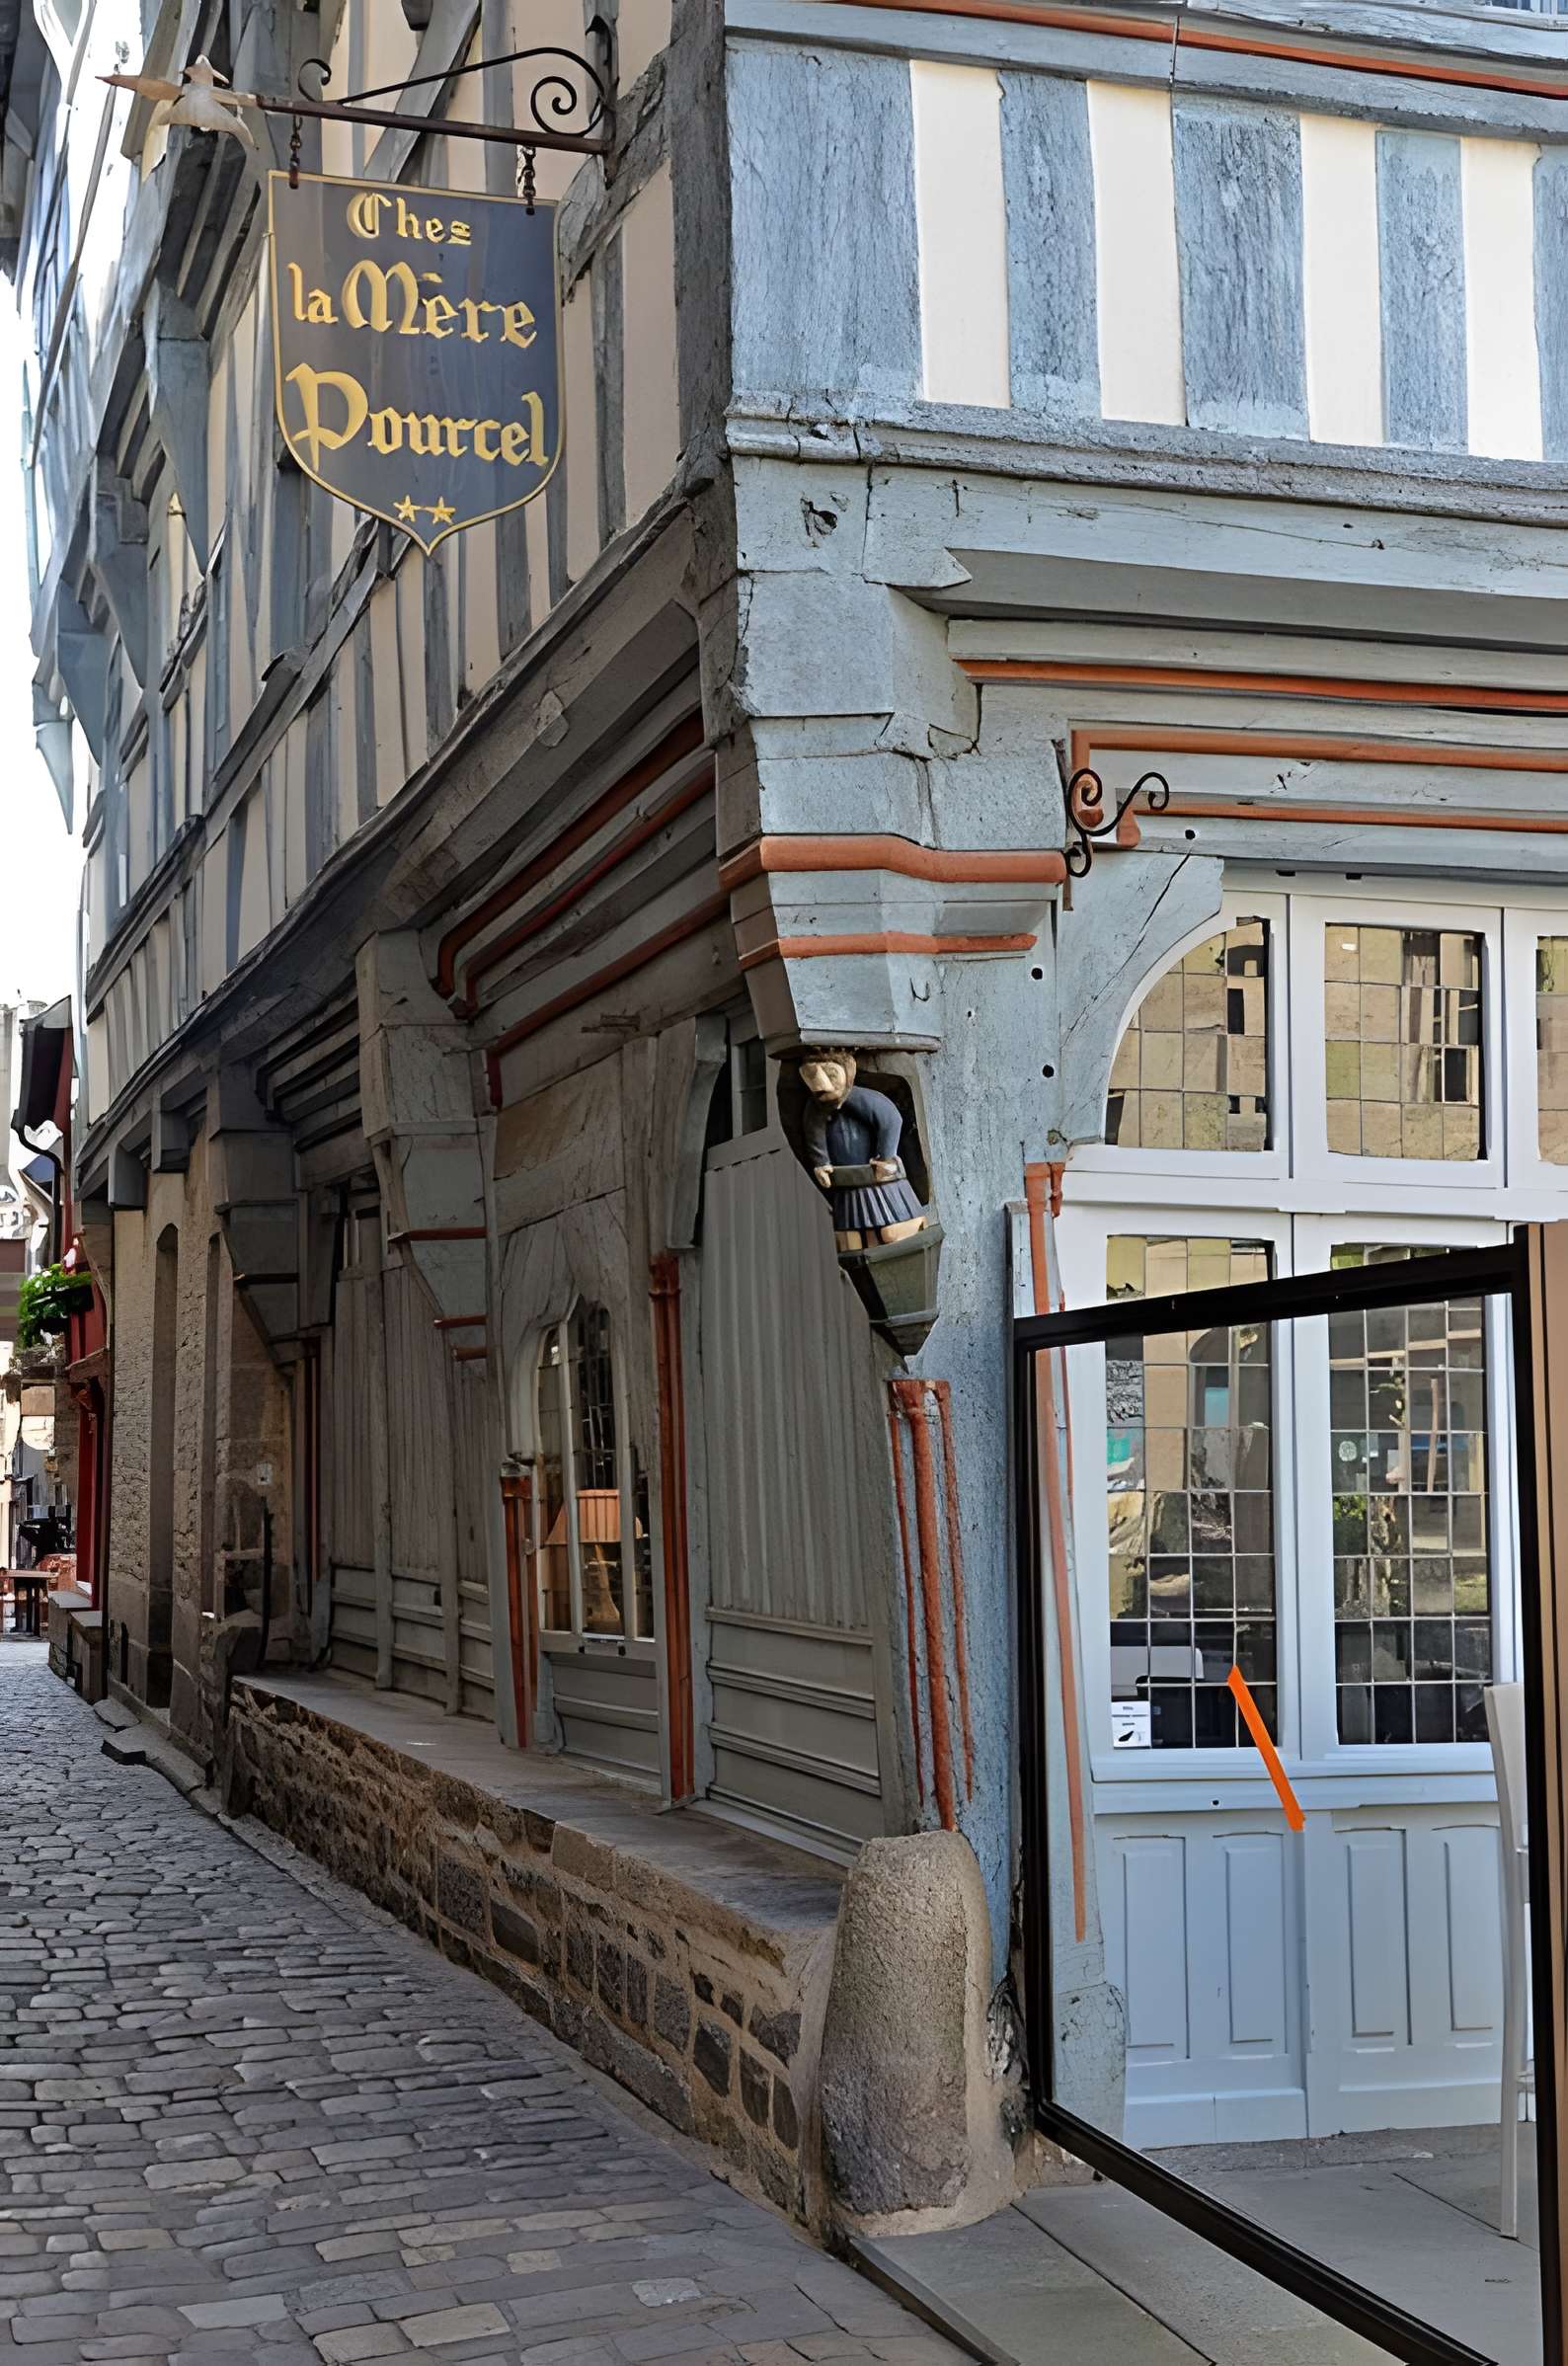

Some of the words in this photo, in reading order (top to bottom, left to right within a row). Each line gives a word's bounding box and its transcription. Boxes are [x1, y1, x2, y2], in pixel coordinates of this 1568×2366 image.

[287, 262, 338, 324] la
[342, 259, 537, 348] Mère
[285, 362, 549, 471] Pourcel
